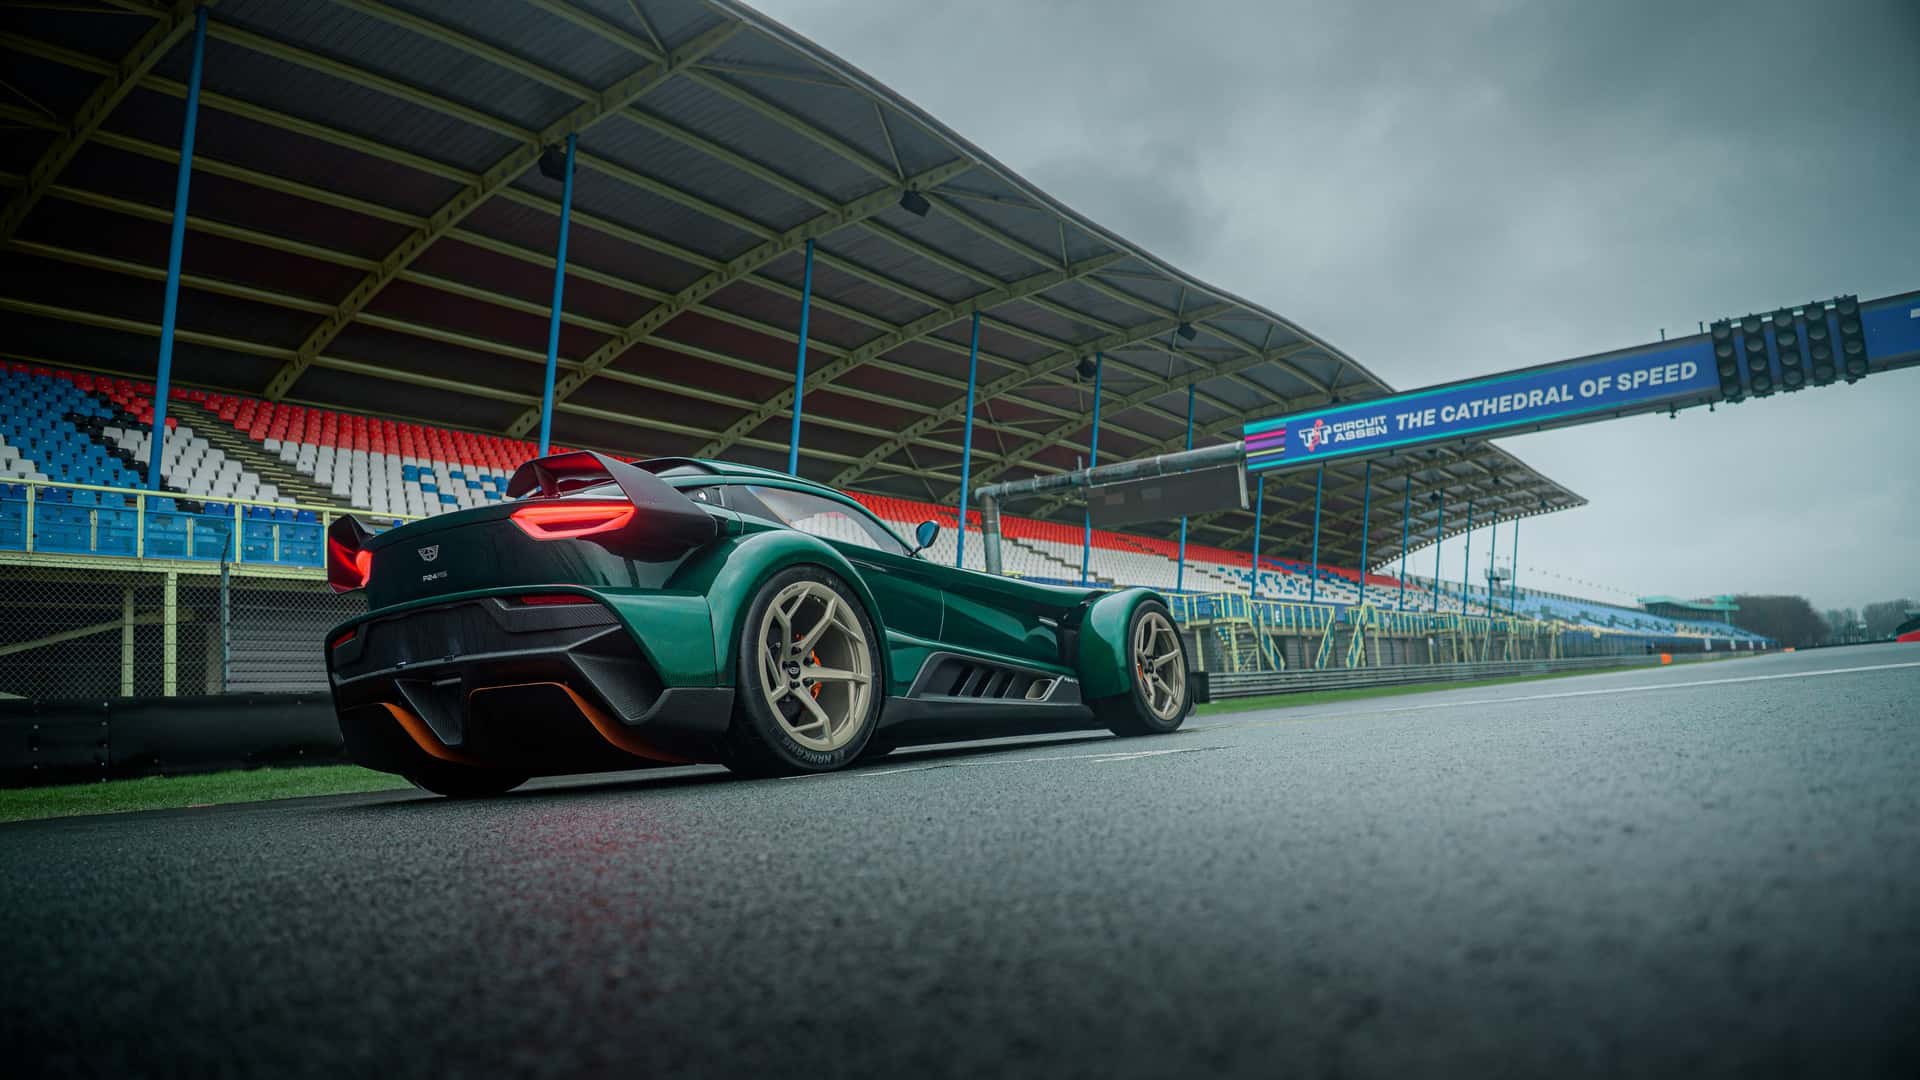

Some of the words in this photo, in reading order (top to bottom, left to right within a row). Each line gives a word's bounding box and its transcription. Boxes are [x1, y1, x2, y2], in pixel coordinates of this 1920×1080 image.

[1396, 408, 1437, 431] THE
[1440, 384, 1574, 423] CATHEDRAL
[1579, 376, 1612, 398] OF
[1616, 361, 1698, 392] SPEED
[1333, 415, 1387, 433] CIRCUIT
[1334, 424, 1388, 443] ASSEN
